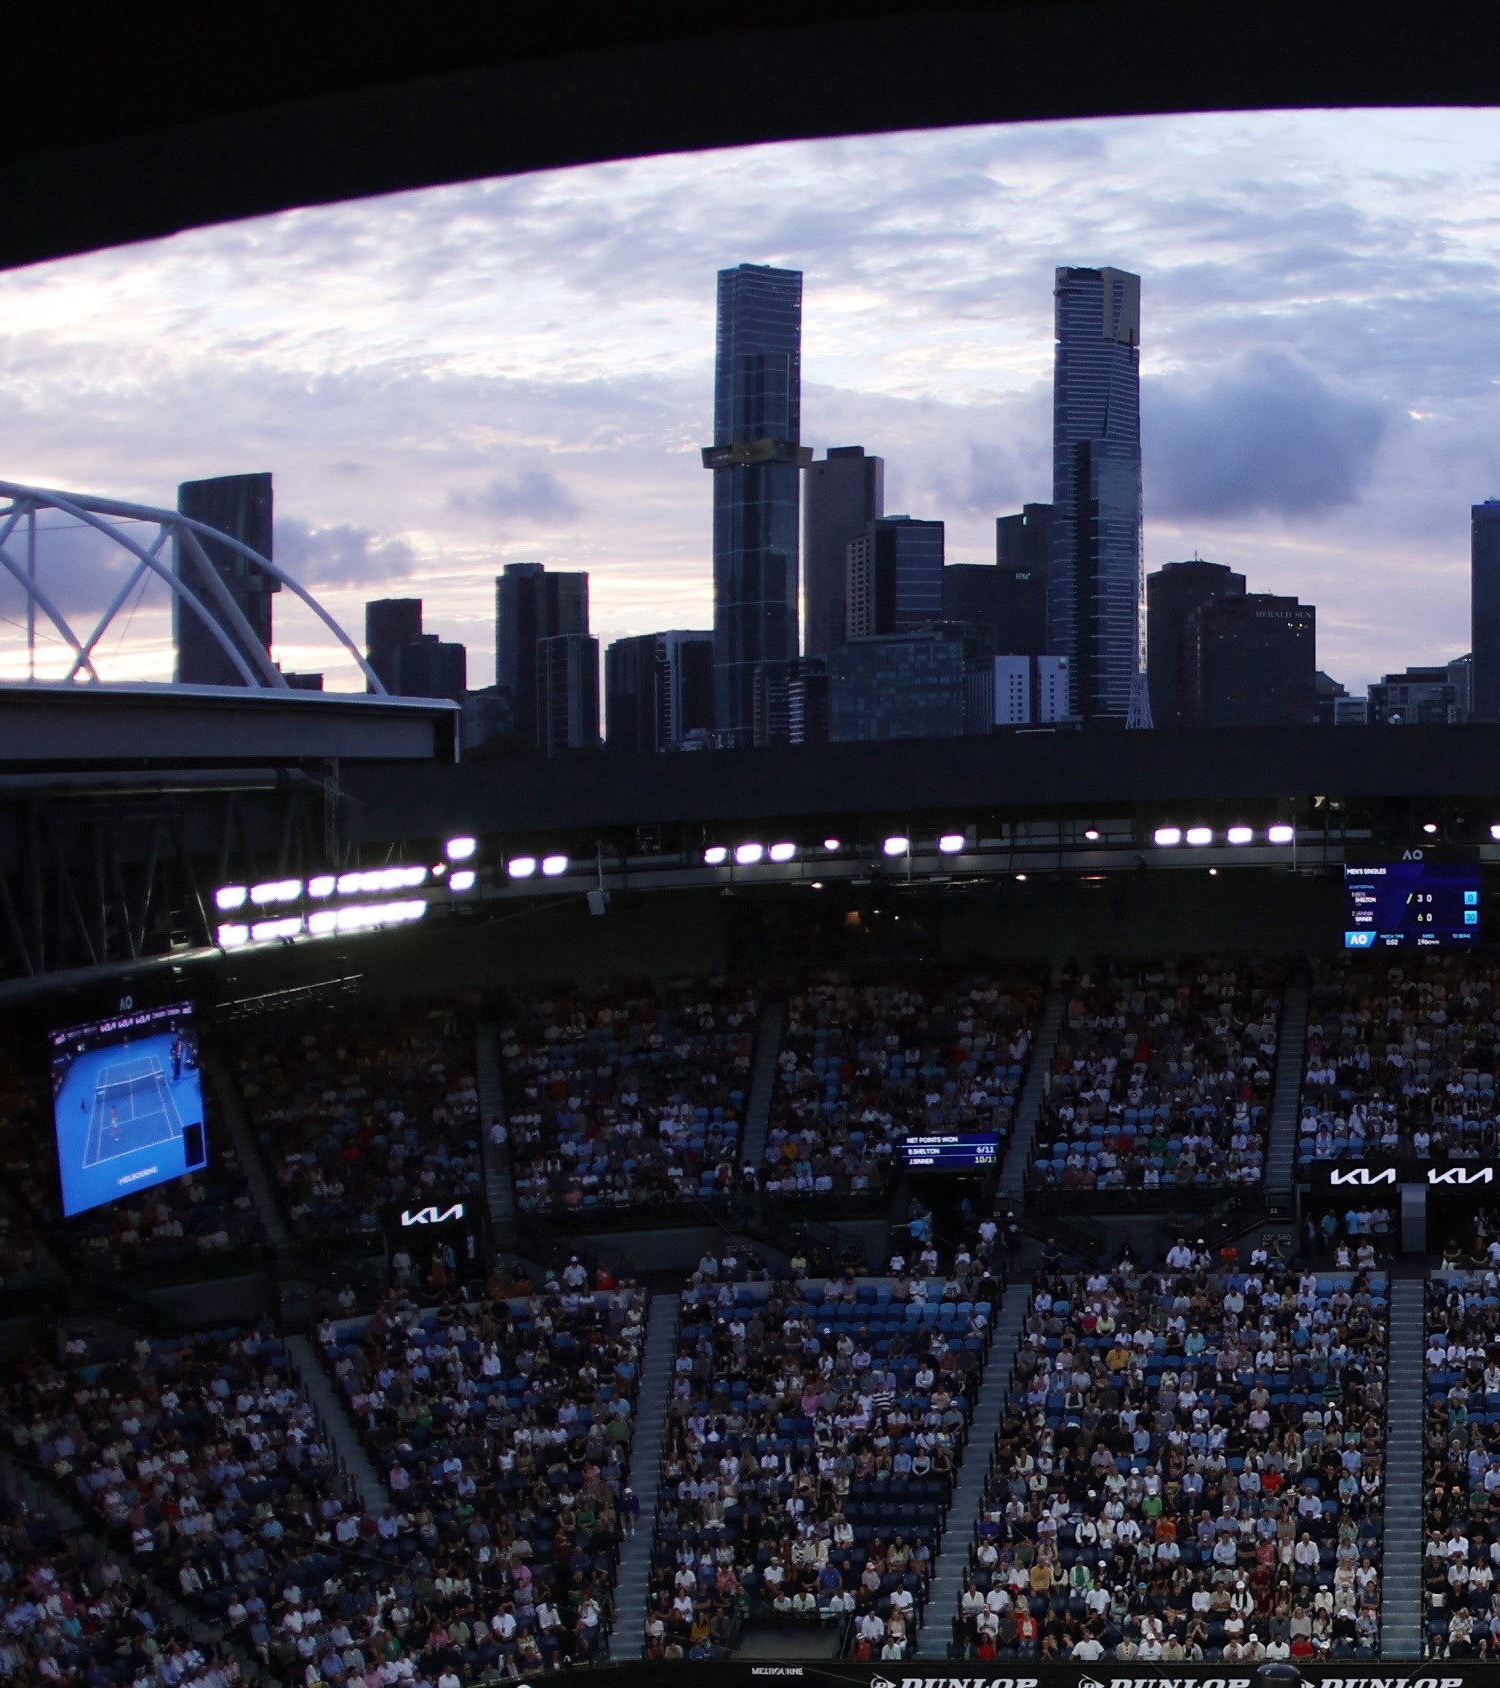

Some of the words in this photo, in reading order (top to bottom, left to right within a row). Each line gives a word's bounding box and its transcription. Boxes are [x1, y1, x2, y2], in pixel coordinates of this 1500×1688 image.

[1402, 849, 1423, 860] AO
[1417, 894, 1423, 902] 3
[1426, 894, 1432, 902] 0
[1417, 913, 1423, 921] 6
[1426, 913, 1432, 921] 0
[1350, 934, 1368, 945] AO
[1331, 1168, 1396, 1185] KIA
[1427, 1167, 1493, 1184] KIA
[401, 1203, 464, 1226] KIA
